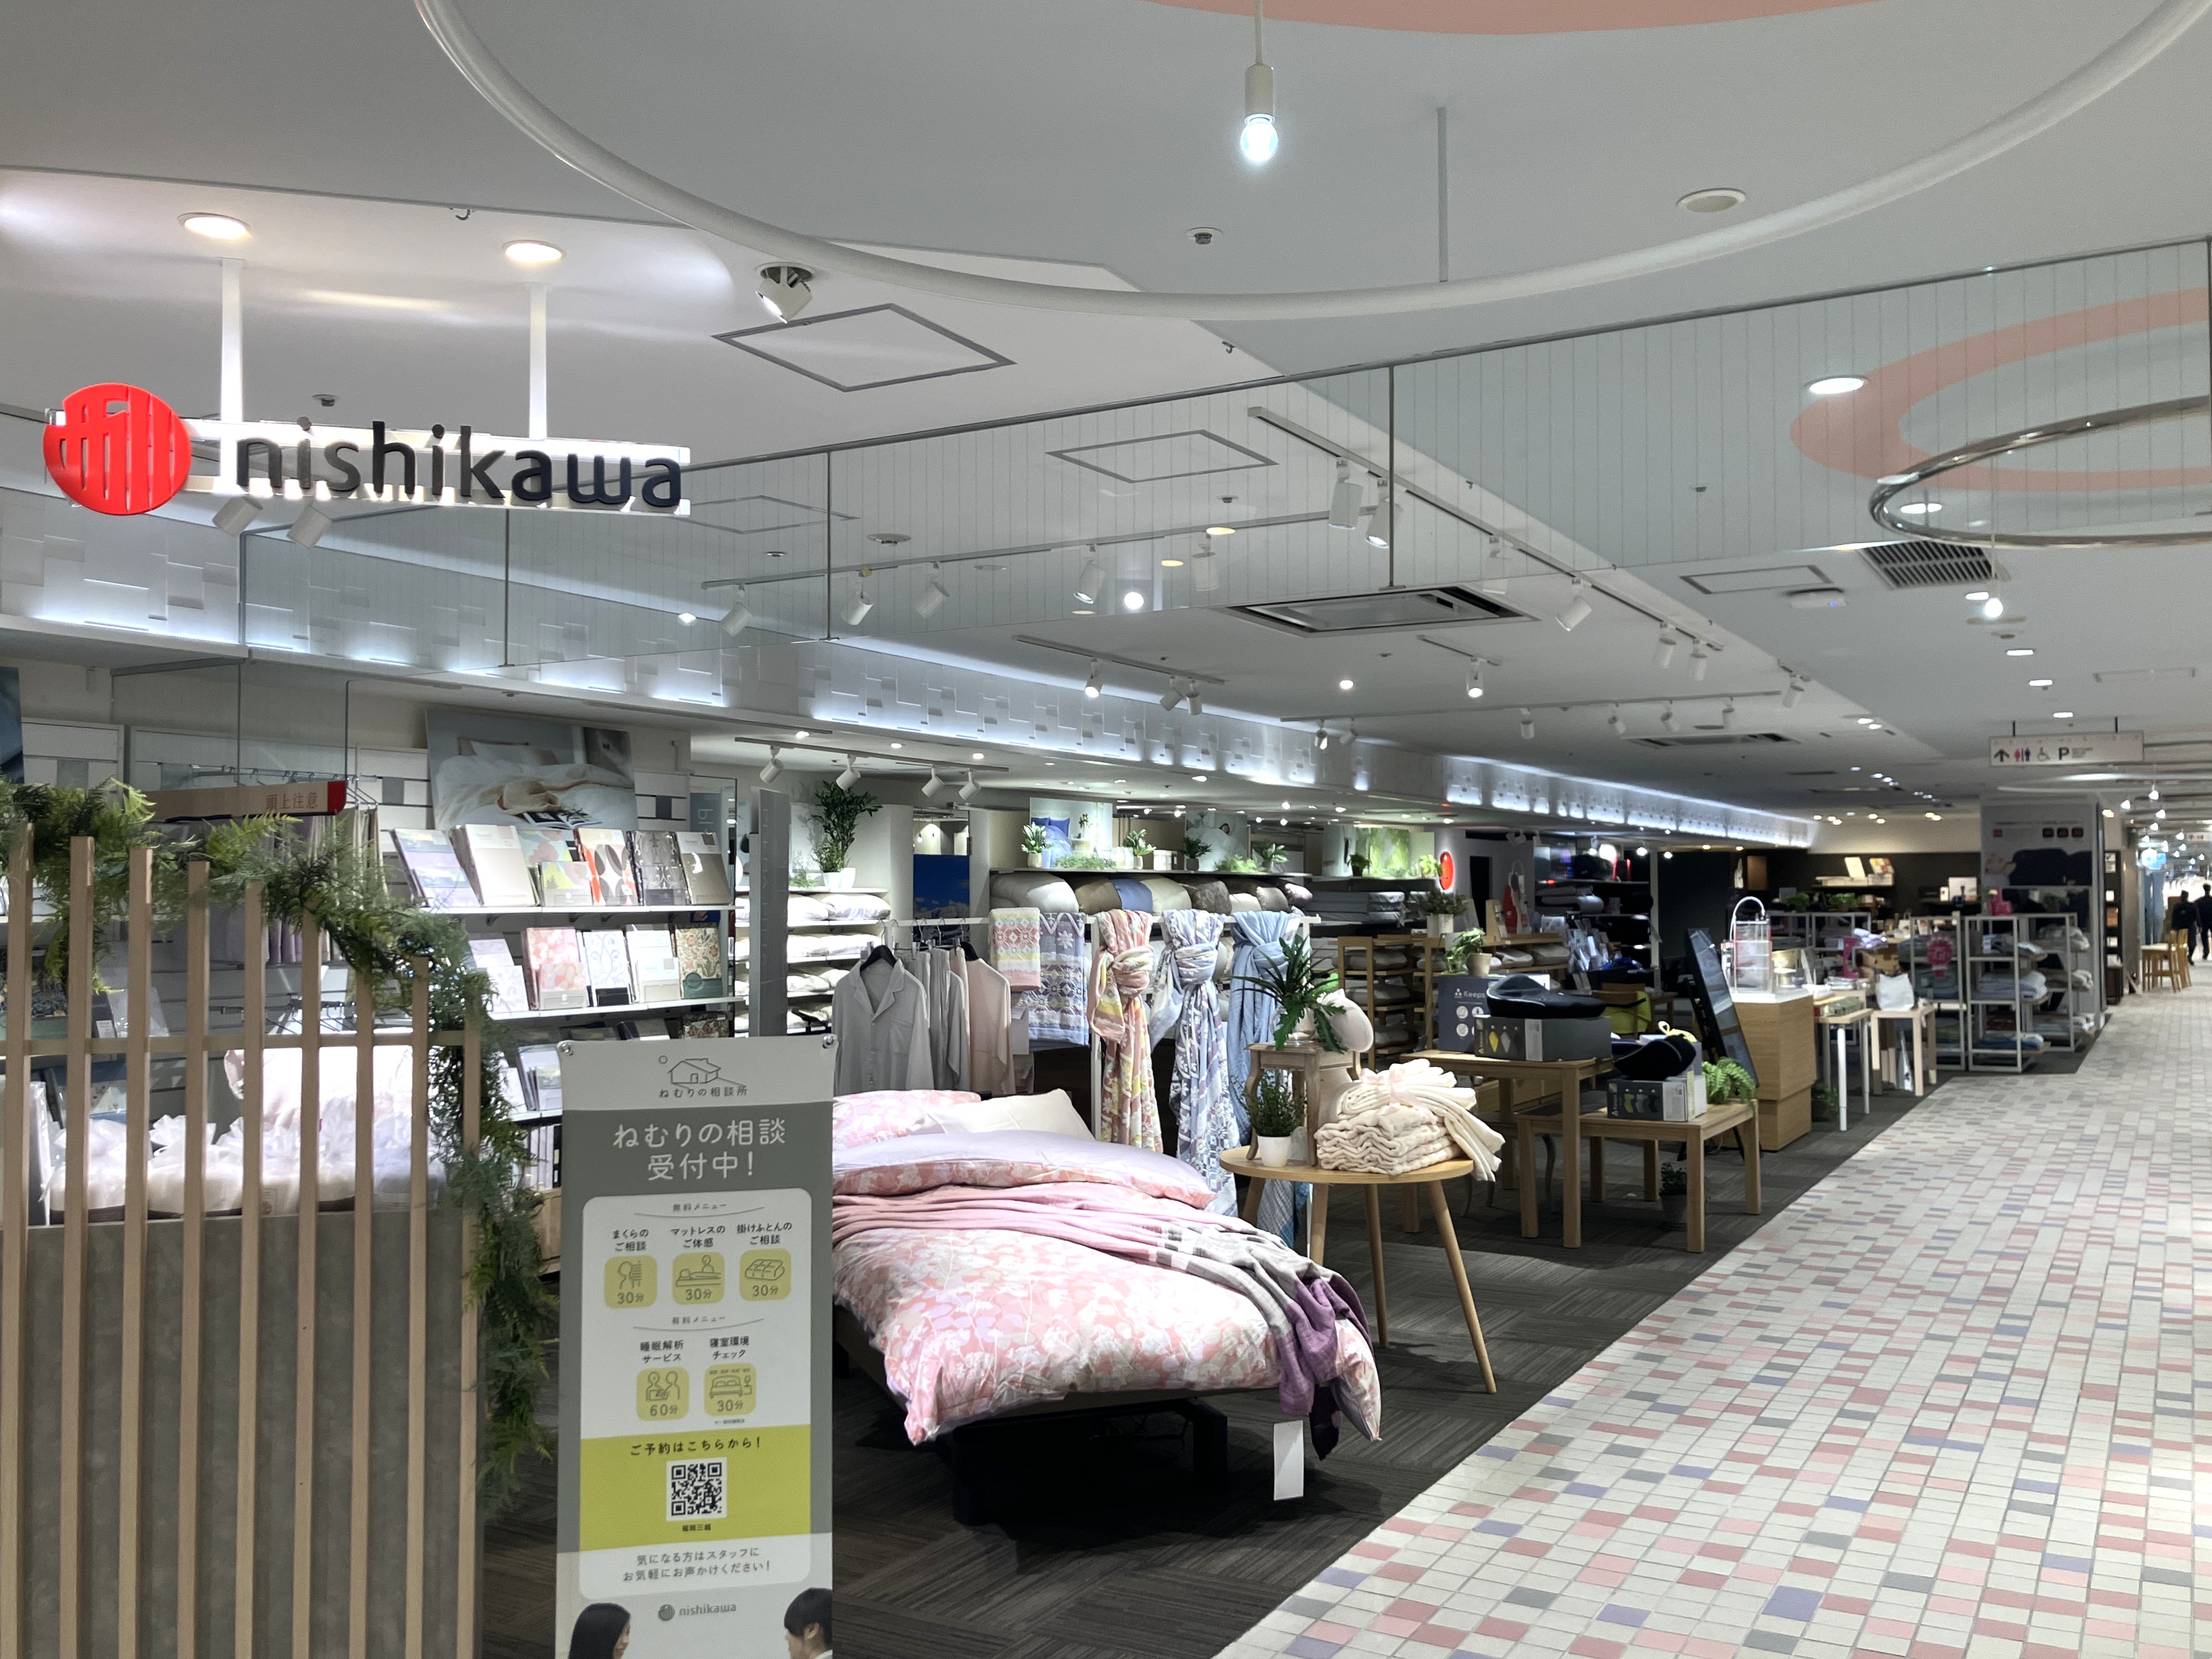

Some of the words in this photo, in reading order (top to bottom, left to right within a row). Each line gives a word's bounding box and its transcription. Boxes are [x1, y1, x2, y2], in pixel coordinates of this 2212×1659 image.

[237, 416, 683, 507] nishikawa
[265, 792, 318, 811] 頭上注意
[659, 1085, 747, 1098] ねむりの相談所
[613, 1117, 786, 1148] ねむりの相談
[648, 1151, 753, 1181] 受付中！
[671, 1225, 726, 1236] マットレスの
[737, 1222, 792, 1233] 掛けふとんの
[613, 1229, 649, 1239] まくらの
[750, 1235, 780, 1245] ご相談
[615, 1242, 646, 1252] ご相談
[683, 1238, 713, 1248] ご体感
[686, 1288, 712, 1300] 30分
[752, 1285, 779, 1297] 30分
[617, 1292, 644, 1304] 30分
[640, 1340, 683, 1352] 睡眠解析
[710, 1336, 749, 1348] 寝室環境
[642, 1354, 682, 1364] サービス
[713, 1349, 746, 1360] チェック
[650, 1404, 678, 1417] 60分
[717, 1399, 744, 1412] 30分
[631, 1436, 760, 1456] ご予約はこちらから！
[636, 1548, 759, 1565] 気になる方はスタッフに
[623, 1561, 770, 1582] お気軽にお声かけください！
[679, 1603, 737, 1616] nishikawa
